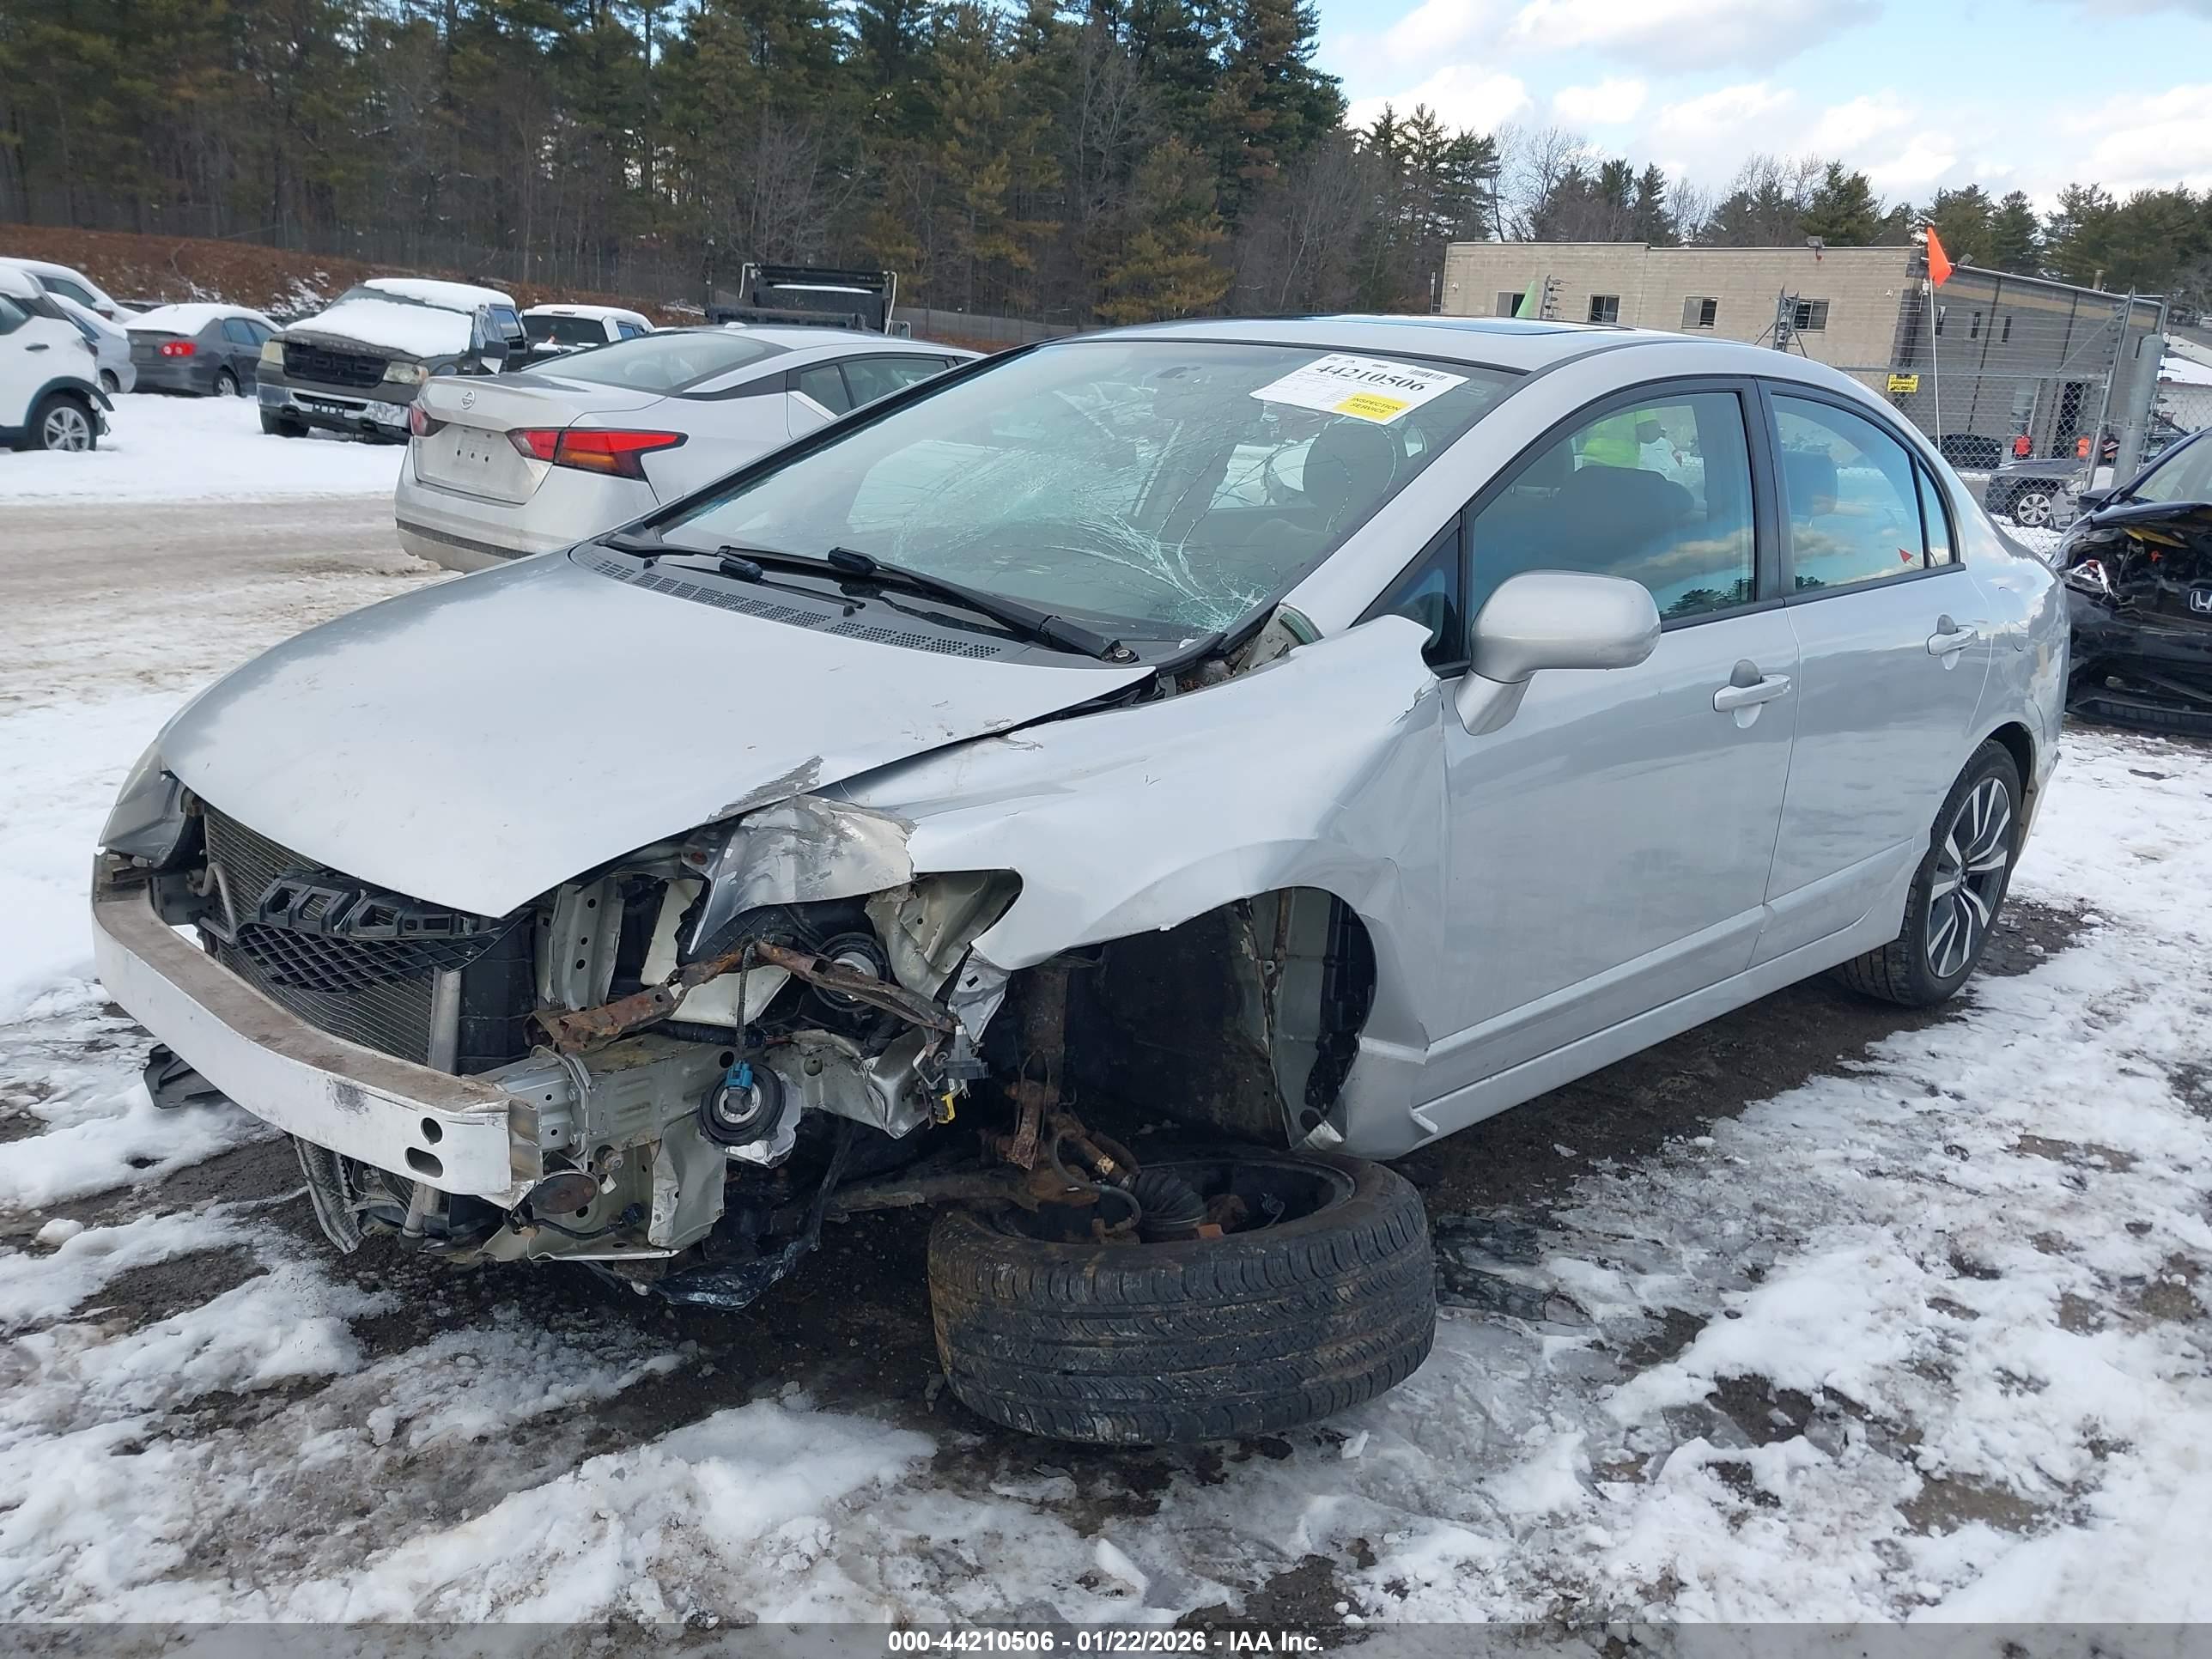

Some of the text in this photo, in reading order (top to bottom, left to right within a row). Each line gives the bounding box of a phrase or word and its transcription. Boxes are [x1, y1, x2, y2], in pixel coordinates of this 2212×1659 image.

[1316, 364, 1431, 391] 44210506
[1349, 402, 1389, 414] SERVICE
[1351, 397, 1401, 411] INSPECTION
